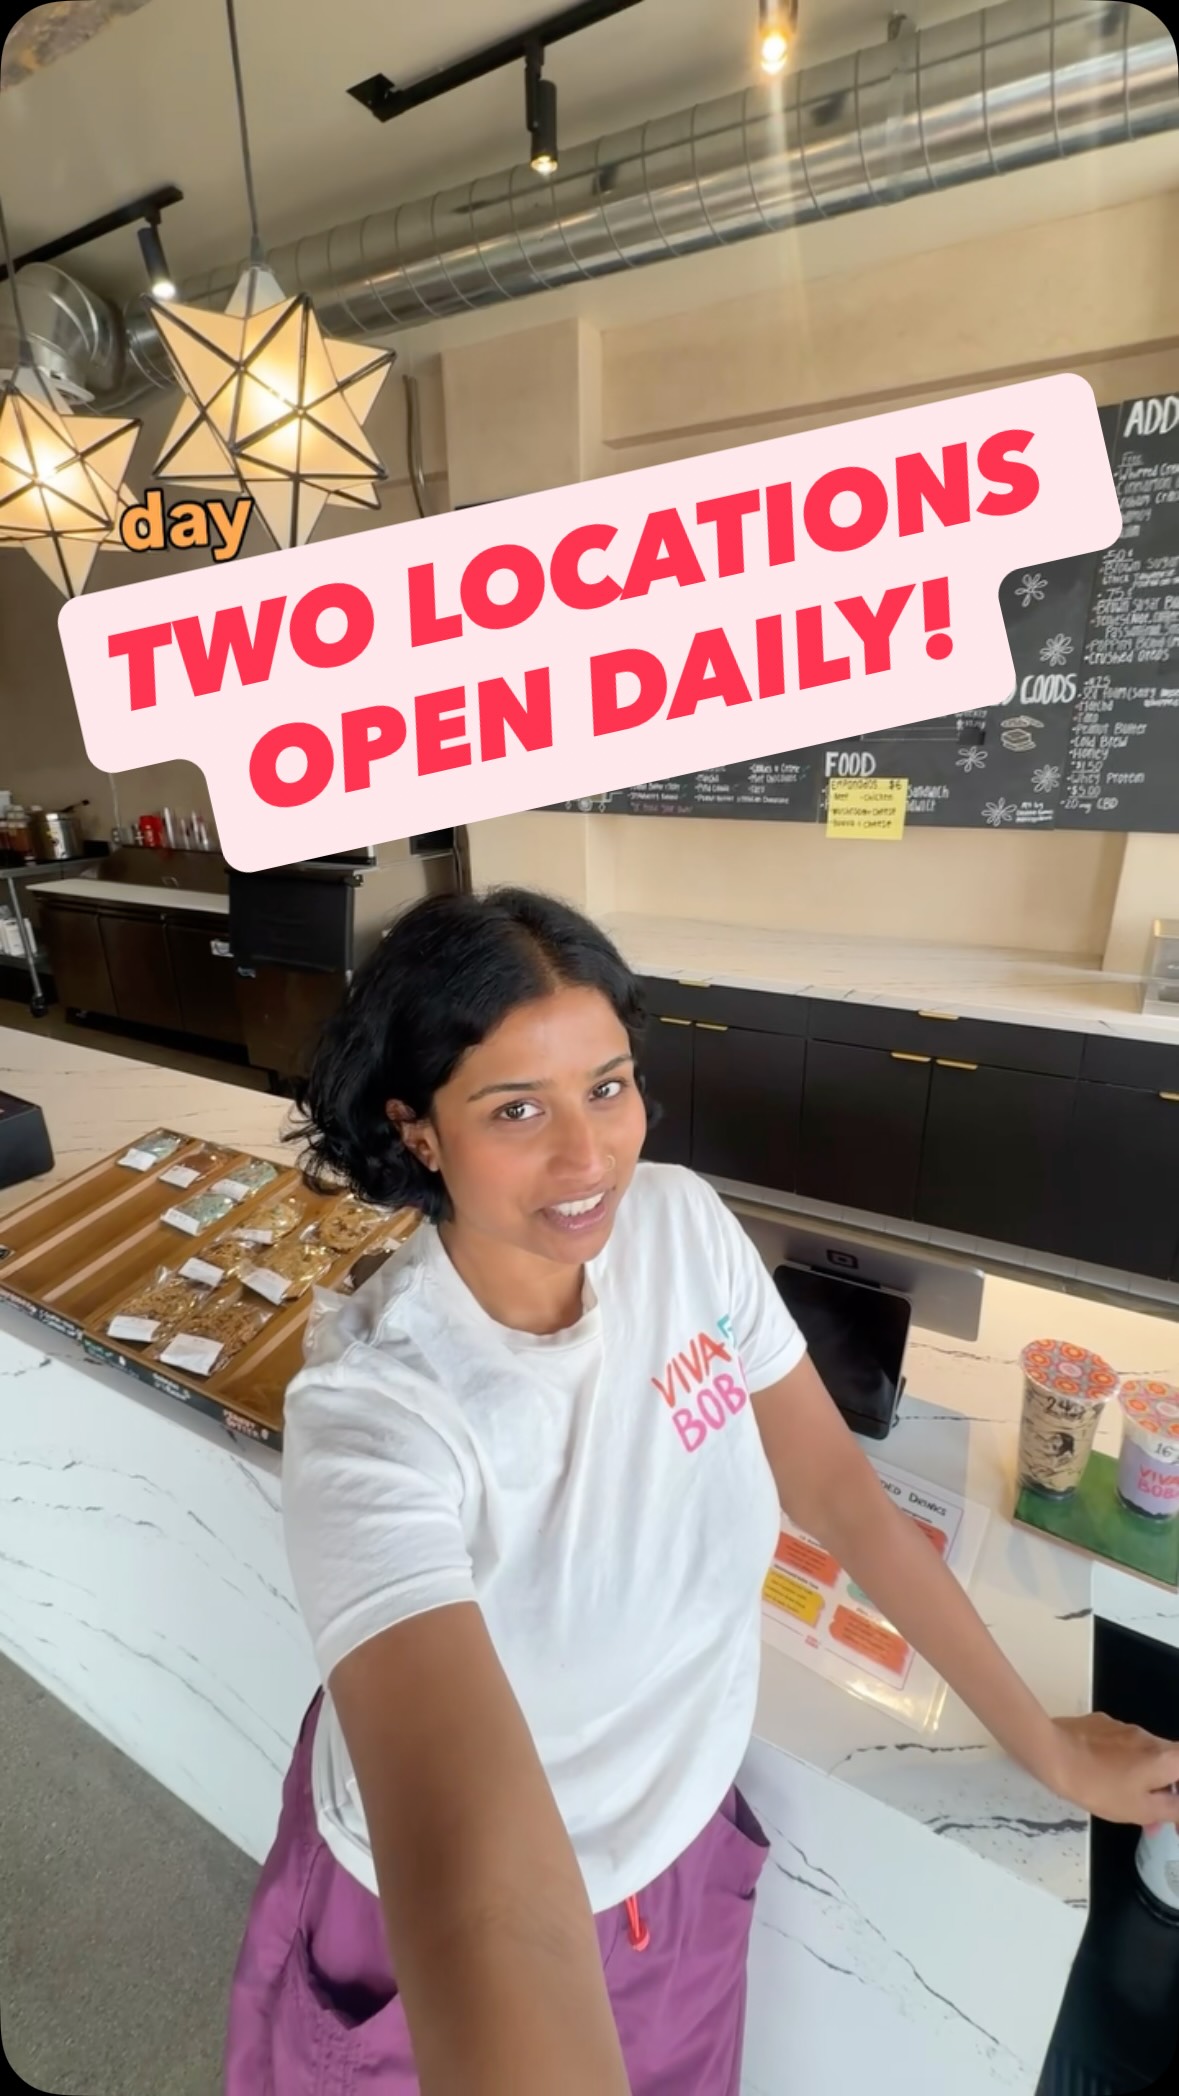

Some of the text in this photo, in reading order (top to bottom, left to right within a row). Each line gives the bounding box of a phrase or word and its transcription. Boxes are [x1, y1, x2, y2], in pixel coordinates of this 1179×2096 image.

[825, 751, 876, 777] FOOD
[651, 1332, 732, 1409] VIVA
[672, 1372, 749, 1453] BOB
